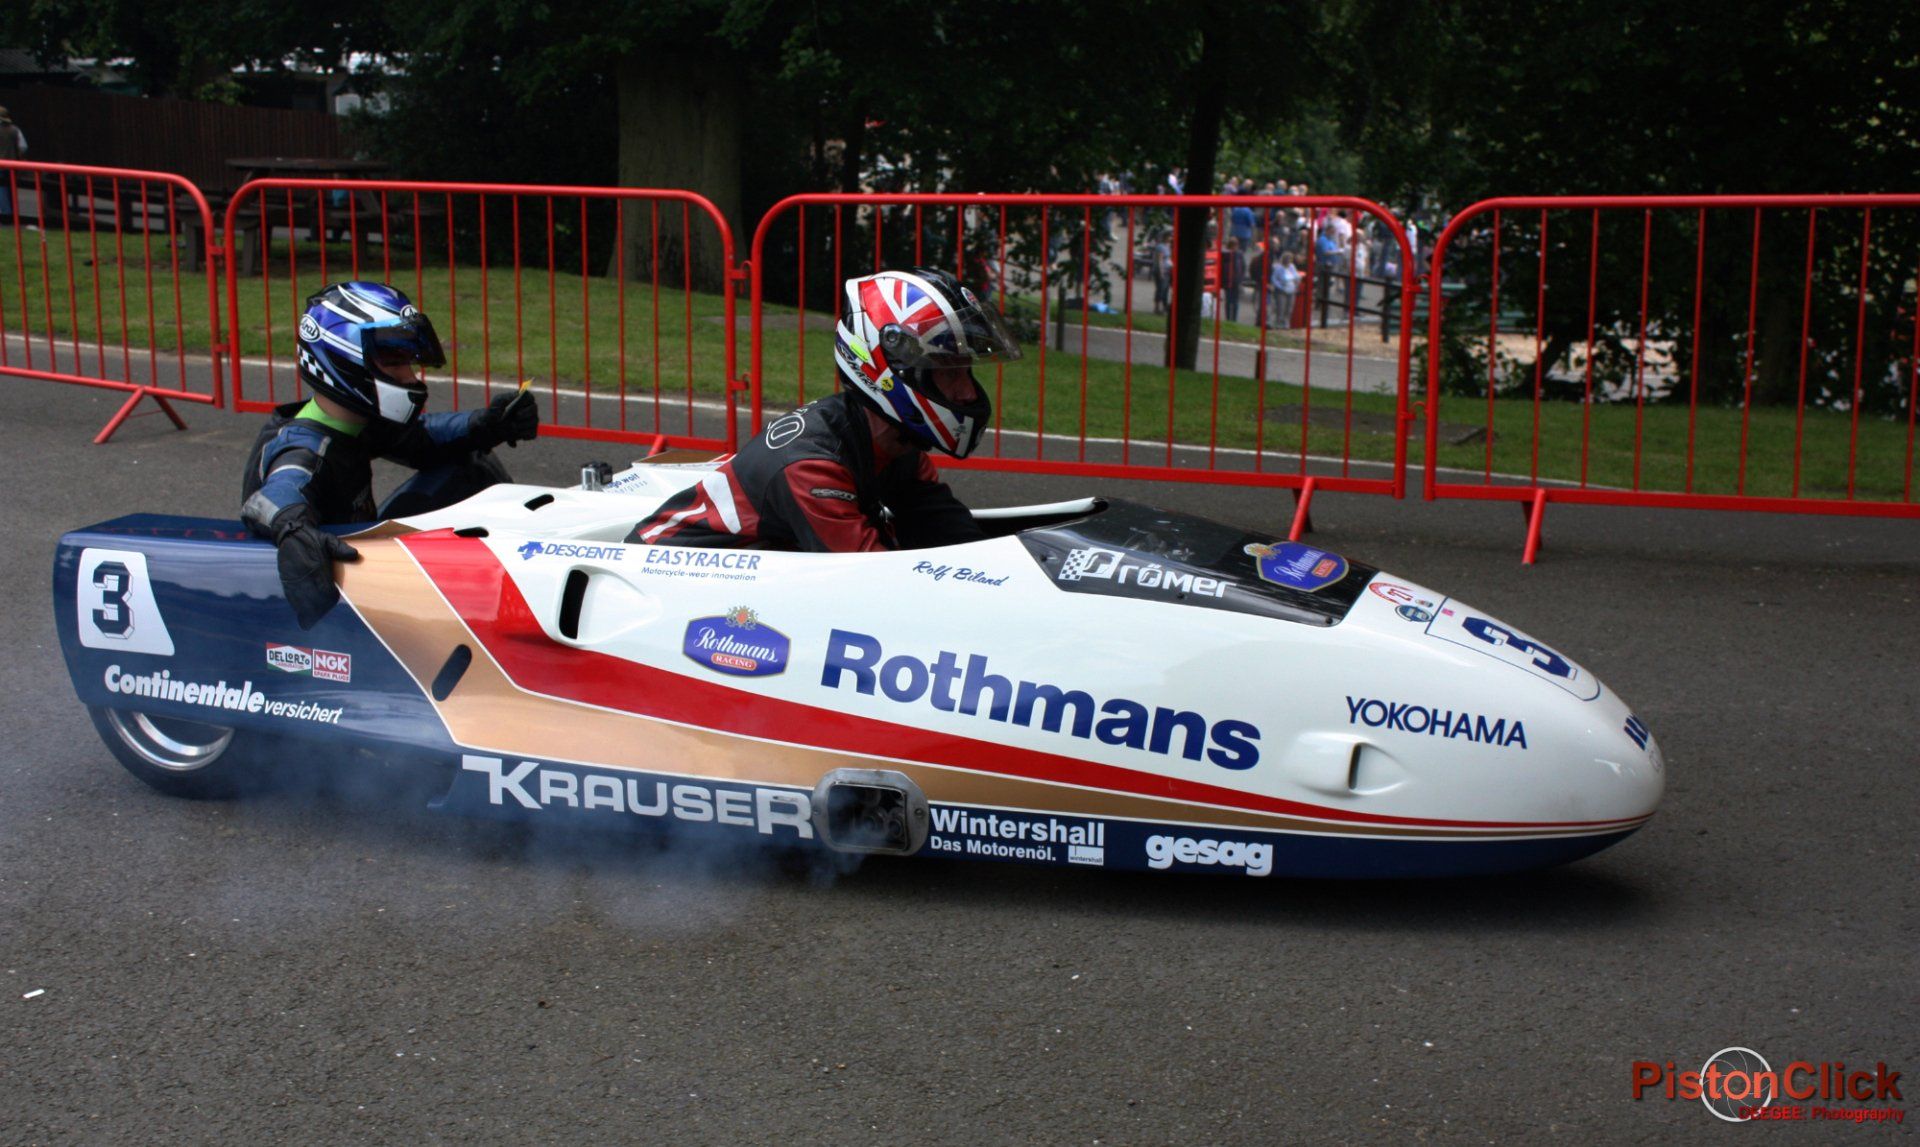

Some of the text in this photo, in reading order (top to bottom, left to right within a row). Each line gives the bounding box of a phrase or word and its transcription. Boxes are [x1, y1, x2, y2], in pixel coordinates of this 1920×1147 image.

[544, 543, 626, 561] DESCENTE
[645, 548, 762, 570] EASYRACER
[641, 565, 757, 582] Motorcycle-wear innovation
[912, 560, 1010, 587] Rolf Biland
[92, 560, 135, 640] 3
[315, 653, 348, 673] NGK
[693, 626, 779, 663] Rothmans
[716, 654, 753, 669] RACING
[1461, 616, 1578, 681] 3
[104, 664, 344, 725] Continentale versichert
[820, 628, 1262, 771] Rothmans
[1345, 696, 1528, 750] YOKOHAMA
[462, 754, 815, 839] KRAUSER
[930, 808, 1105, 847] Wintershall
[930, 836, 1056, 862] Das Motorenöl.
[1145, 834, 1274, 877] gesag
